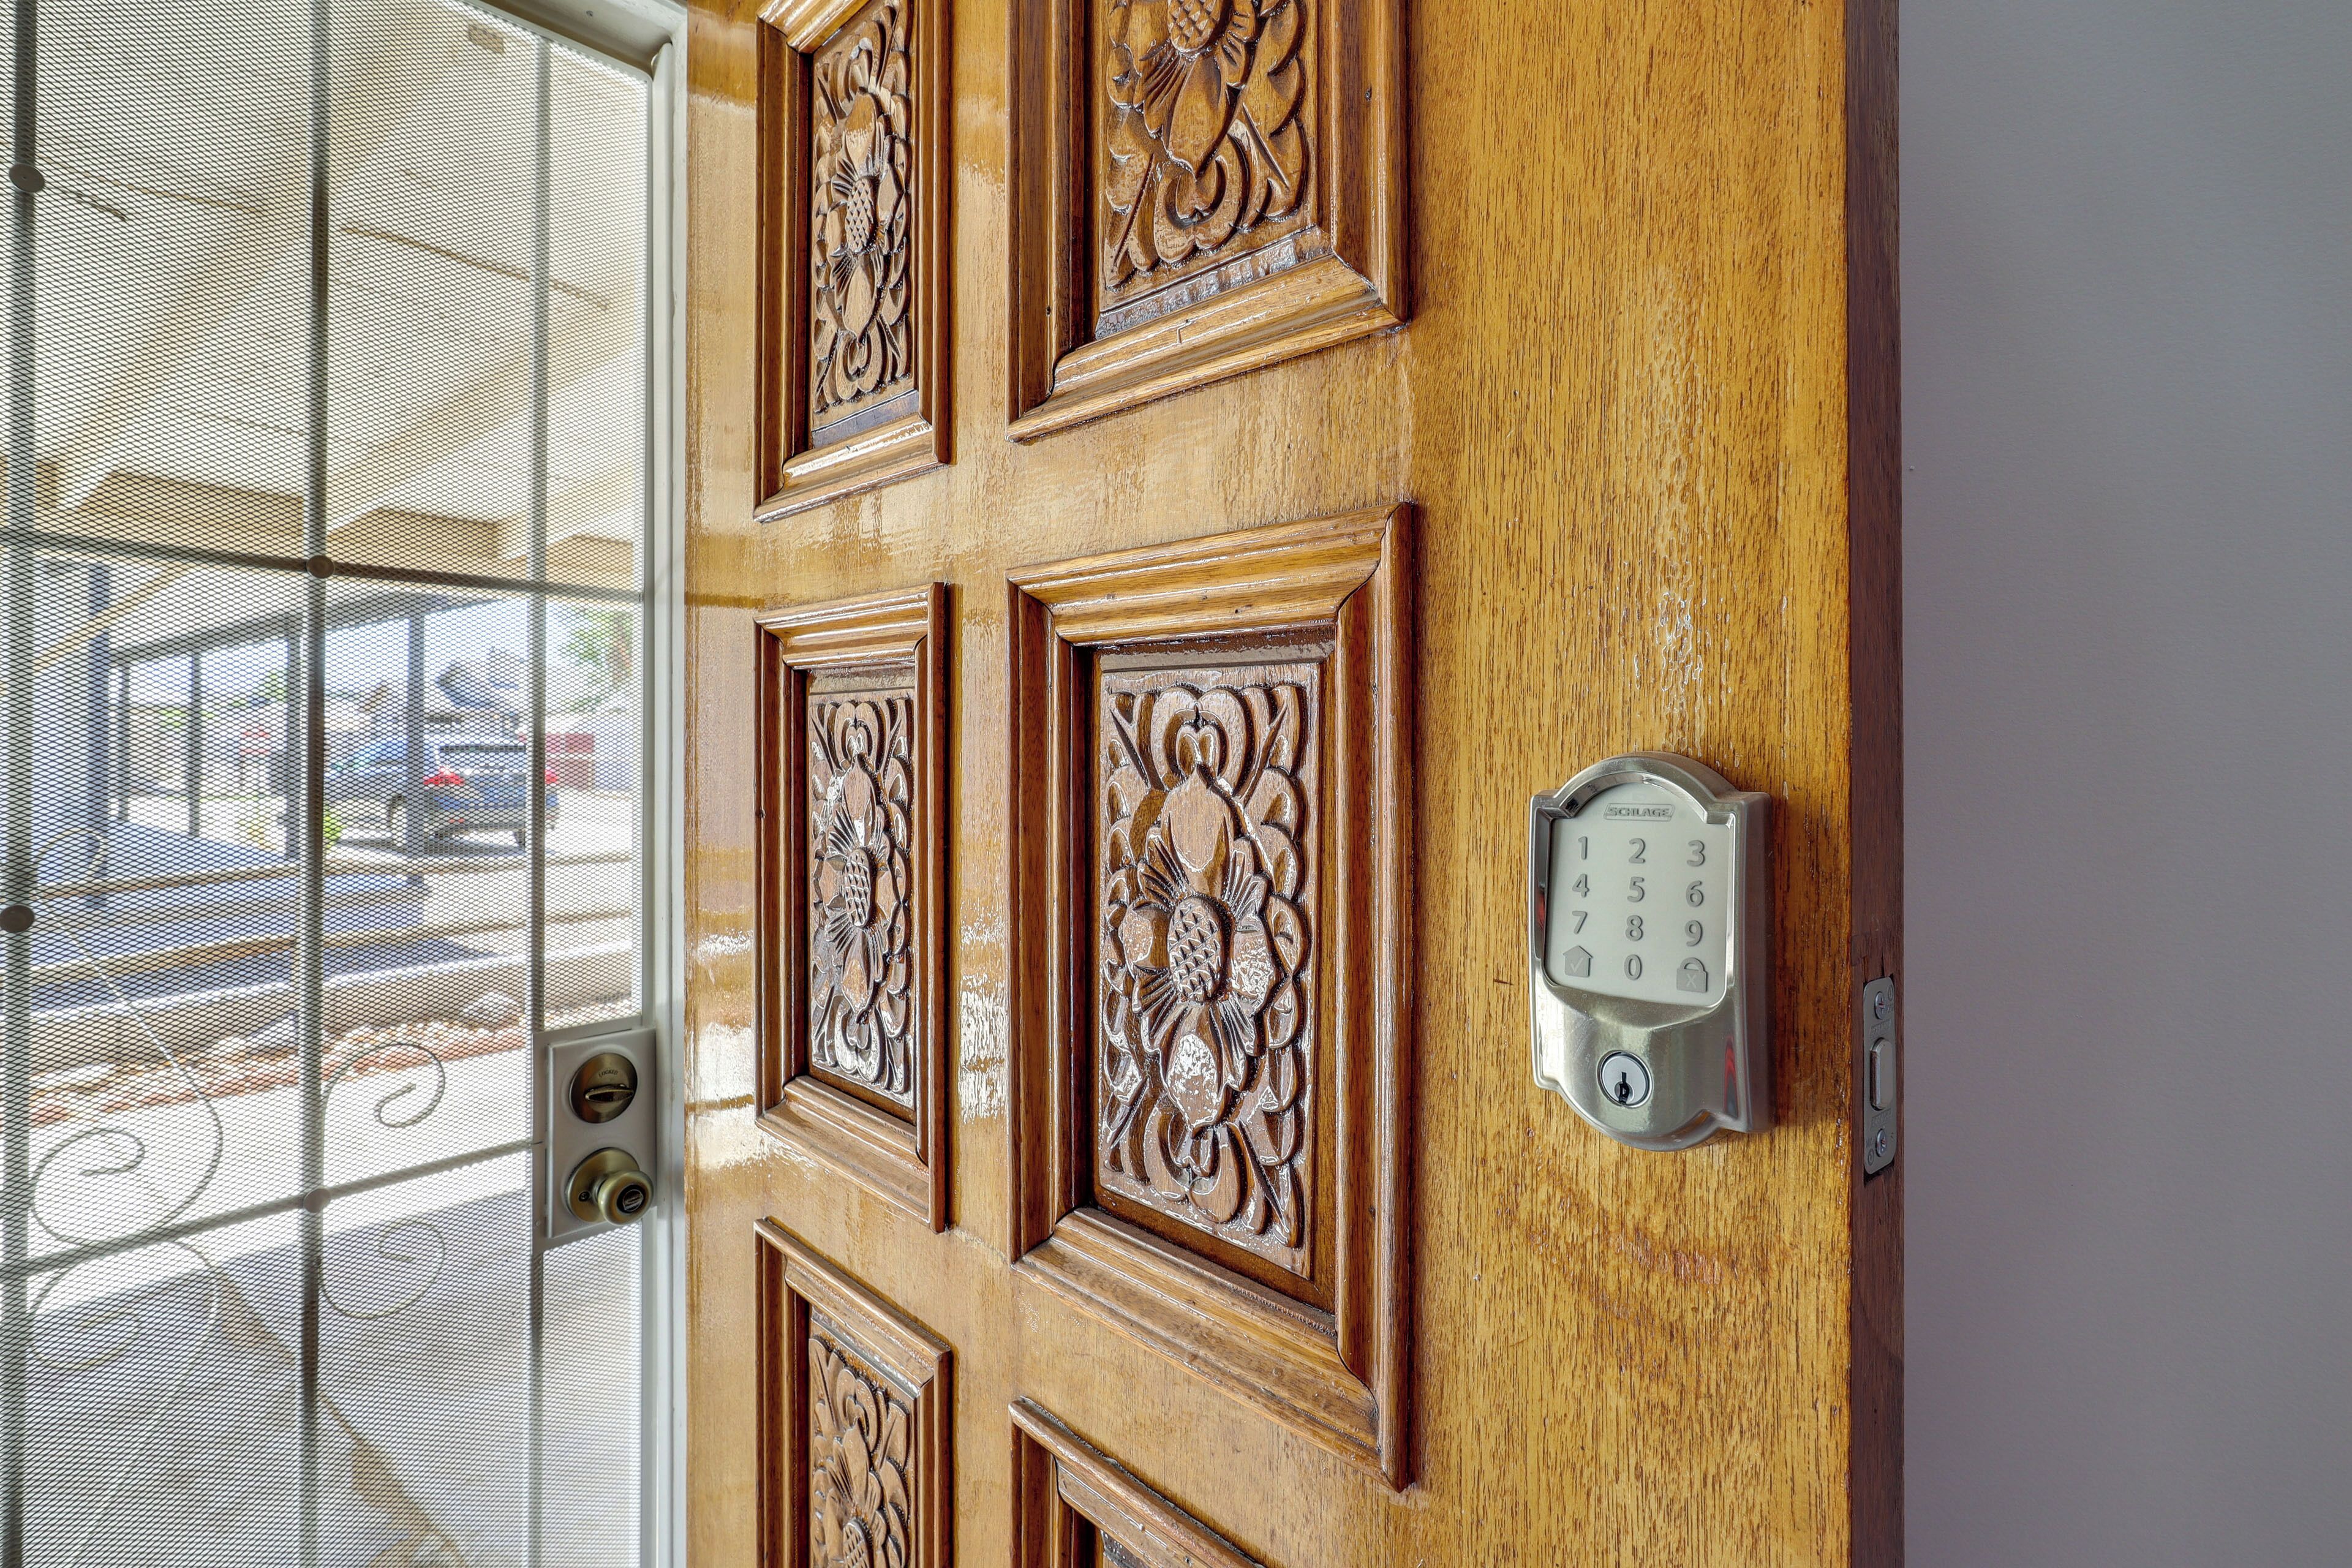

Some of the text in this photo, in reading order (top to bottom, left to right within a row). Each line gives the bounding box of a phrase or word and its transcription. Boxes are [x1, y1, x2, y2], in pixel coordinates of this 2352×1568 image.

[1607, 807, 1672, 818] SCHLAGE
[1577, 836, 1705, 867] 1 2 3
[1572, 873, 1704, 908] 4 5 6
[1572, 910, 1703, 947] 7 8 9
[1624, 954, 1643, 980] 0
[598, 1068, 619, 1078] LOCKED
